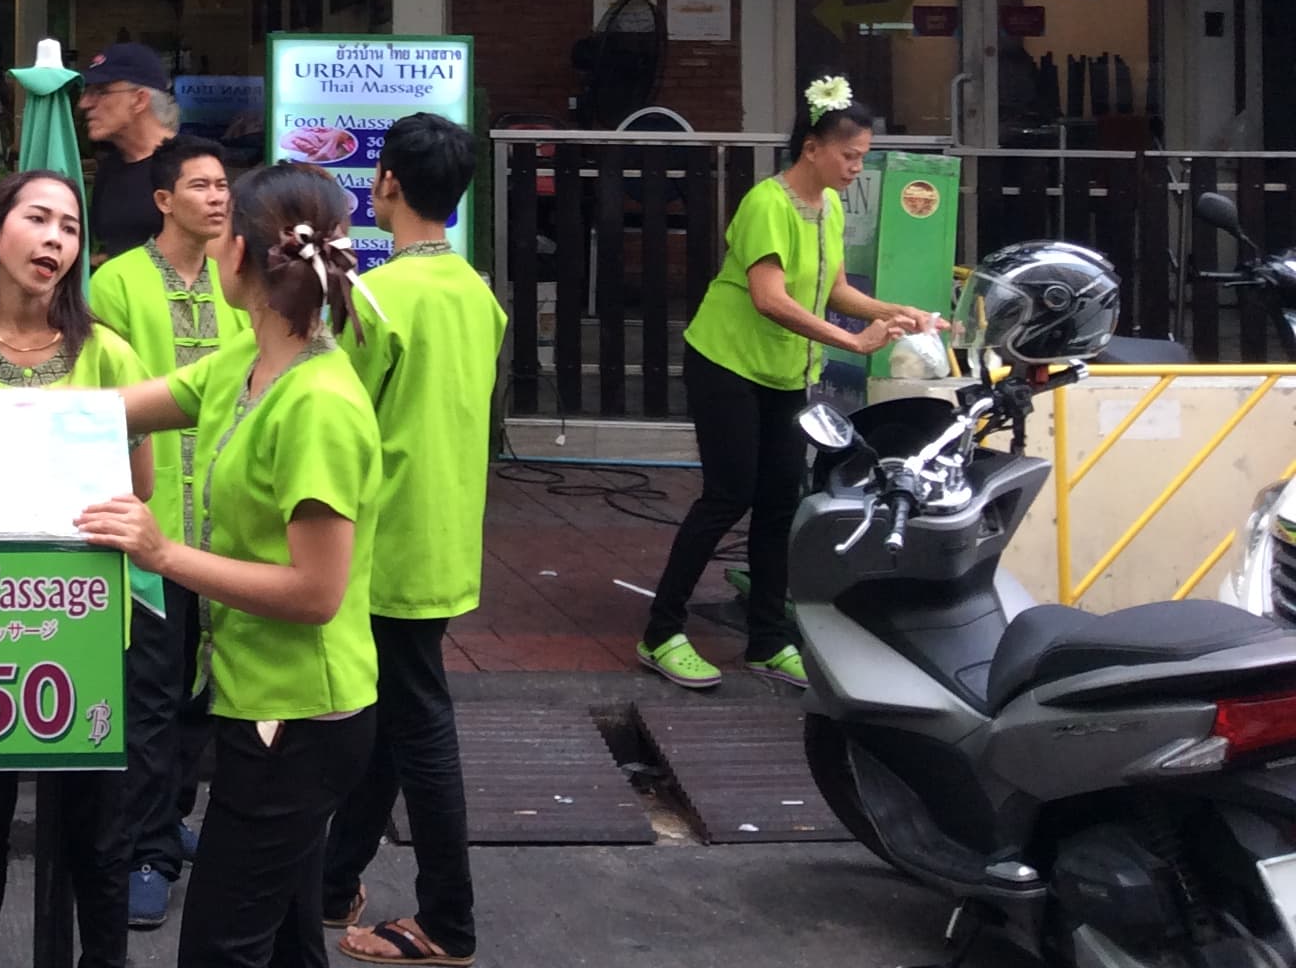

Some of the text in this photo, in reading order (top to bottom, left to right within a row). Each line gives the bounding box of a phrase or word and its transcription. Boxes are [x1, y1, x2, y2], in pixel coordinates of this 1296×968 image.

[387, 42, 410, 61] ไทย
[295, 63, 454, 79] URBAN THAI
[320, 80, 434, 97] Thai Massage
[285, 114, 395, 129] Foot Massa
